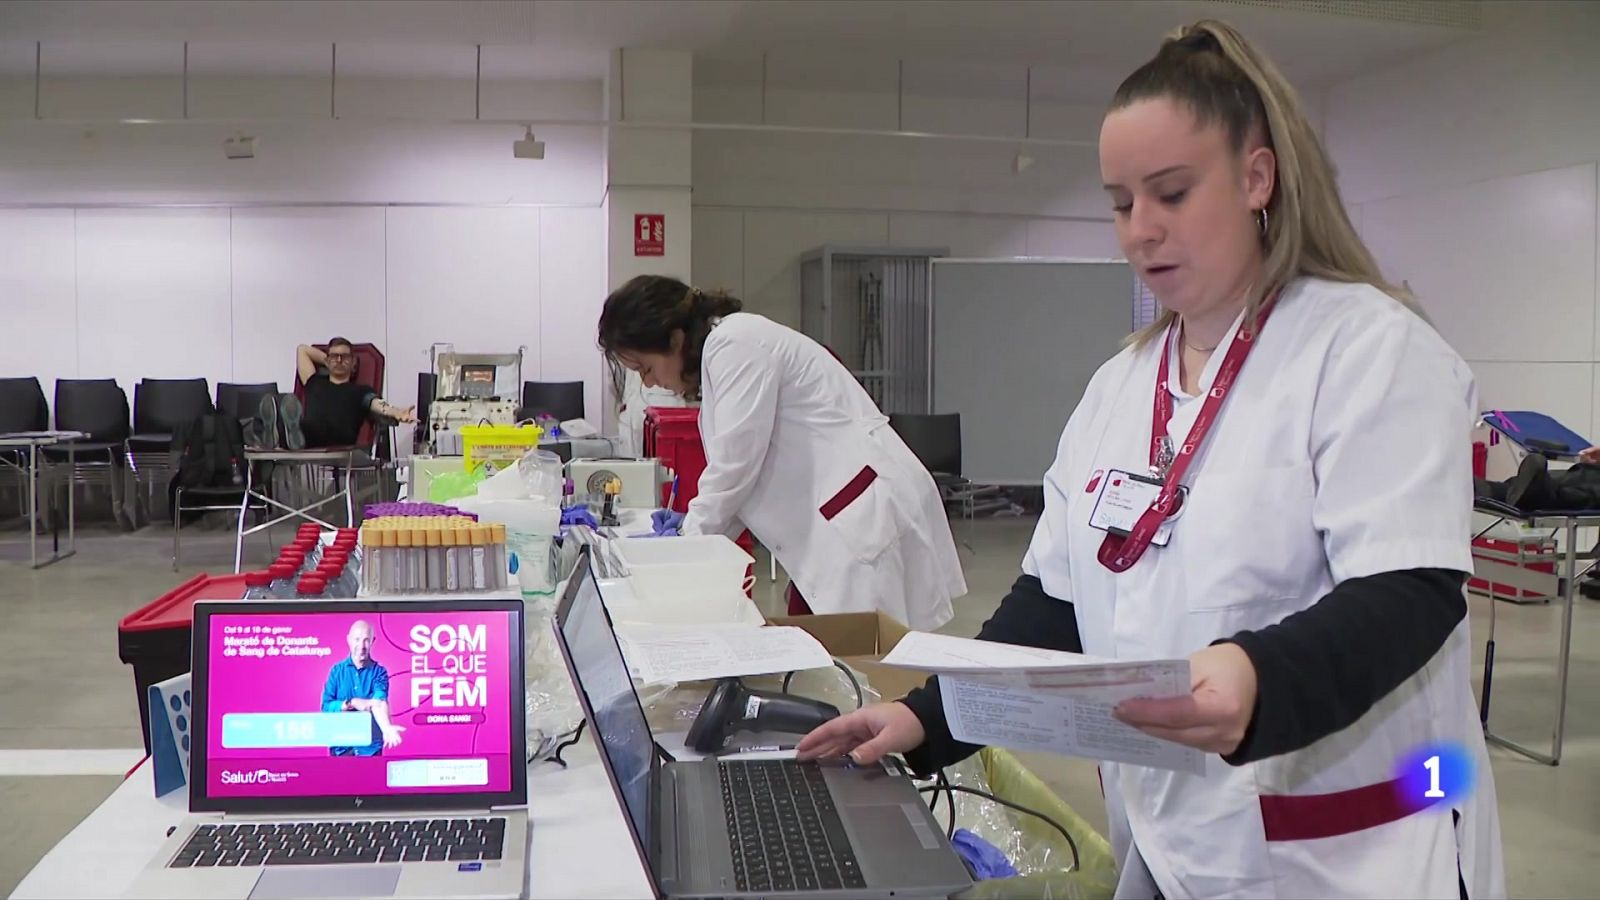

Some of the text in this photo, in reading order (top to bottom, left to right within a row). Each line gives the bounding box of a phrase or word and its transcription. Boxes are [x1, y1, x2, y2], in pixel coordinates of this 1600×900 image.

[224, 635, 319, 646] Marató de Donants
[409, 623, 487, 654] SOM
[223, 645, 332, 658] de Sang de Catalunya
[411, 654, 487, 675] EL QUE
[410, 675, 487, 708] FEM
[426, 715, 448, 723] DONA
